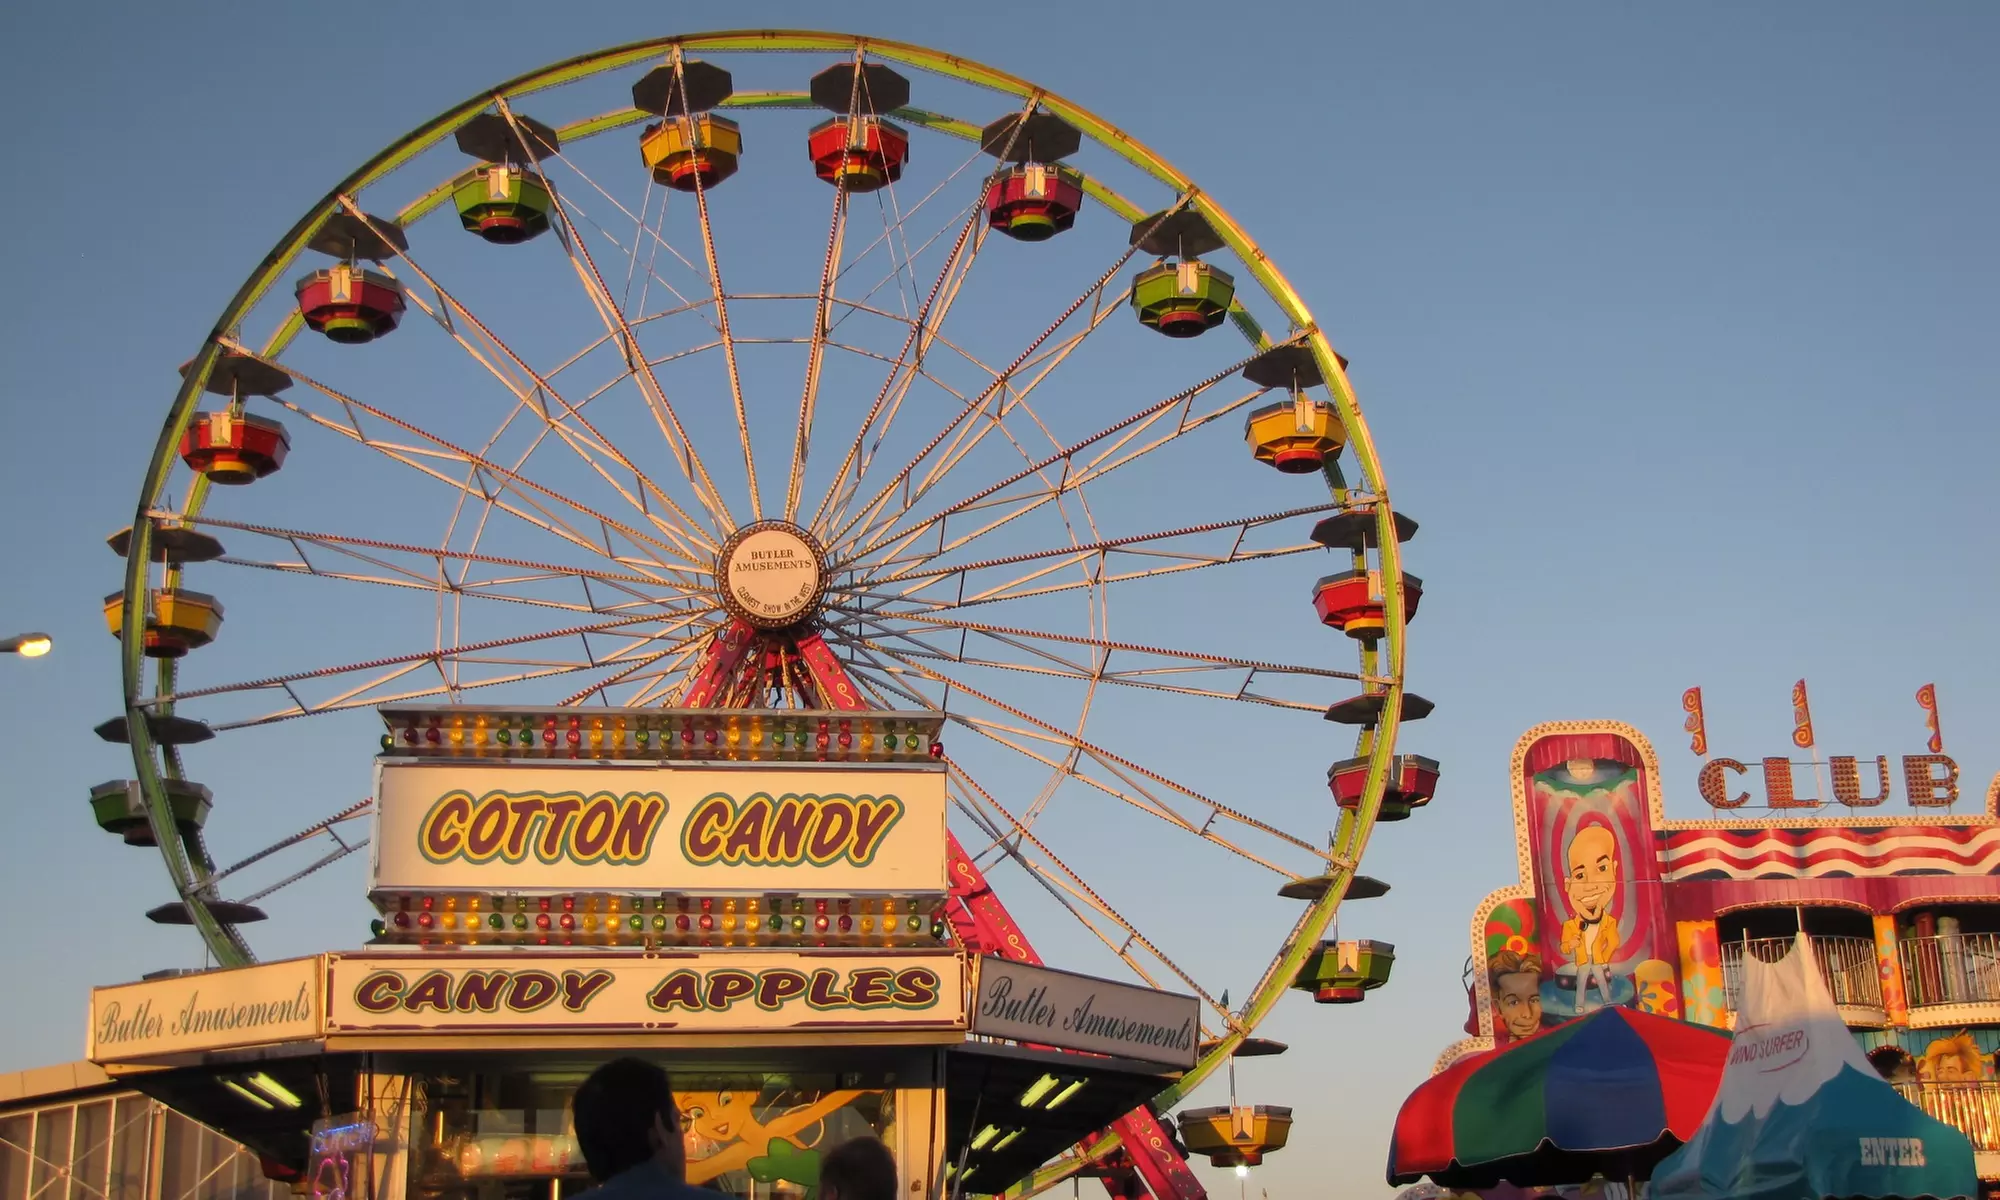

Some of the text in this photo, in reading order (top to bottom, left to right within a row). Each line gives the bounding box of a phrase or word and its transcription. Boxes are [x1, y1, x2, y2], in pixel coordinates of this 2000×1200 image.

[735, 560, 812, 572] AMUSEMENTS
[751, 549, 795, 560] BUTLER
[763, 603, 782, 613] SHOW
[790, 596, 802, 608] THE
[800, 582, 812, 598] WEST
[1698, 754, 1960, 809] CLUB
[418, 789, 906, 868] COTTON CANDY
[353, 968, 941, 1014] CANDY APPLES
[98, 981, 312, 1044] Butler Amusements
[982, 975, 1192, 1052] Butler Amusements
[1759, 1030, 1804, 1059] SURFER
[1859, 1137, 1925, 1167] ENTER
